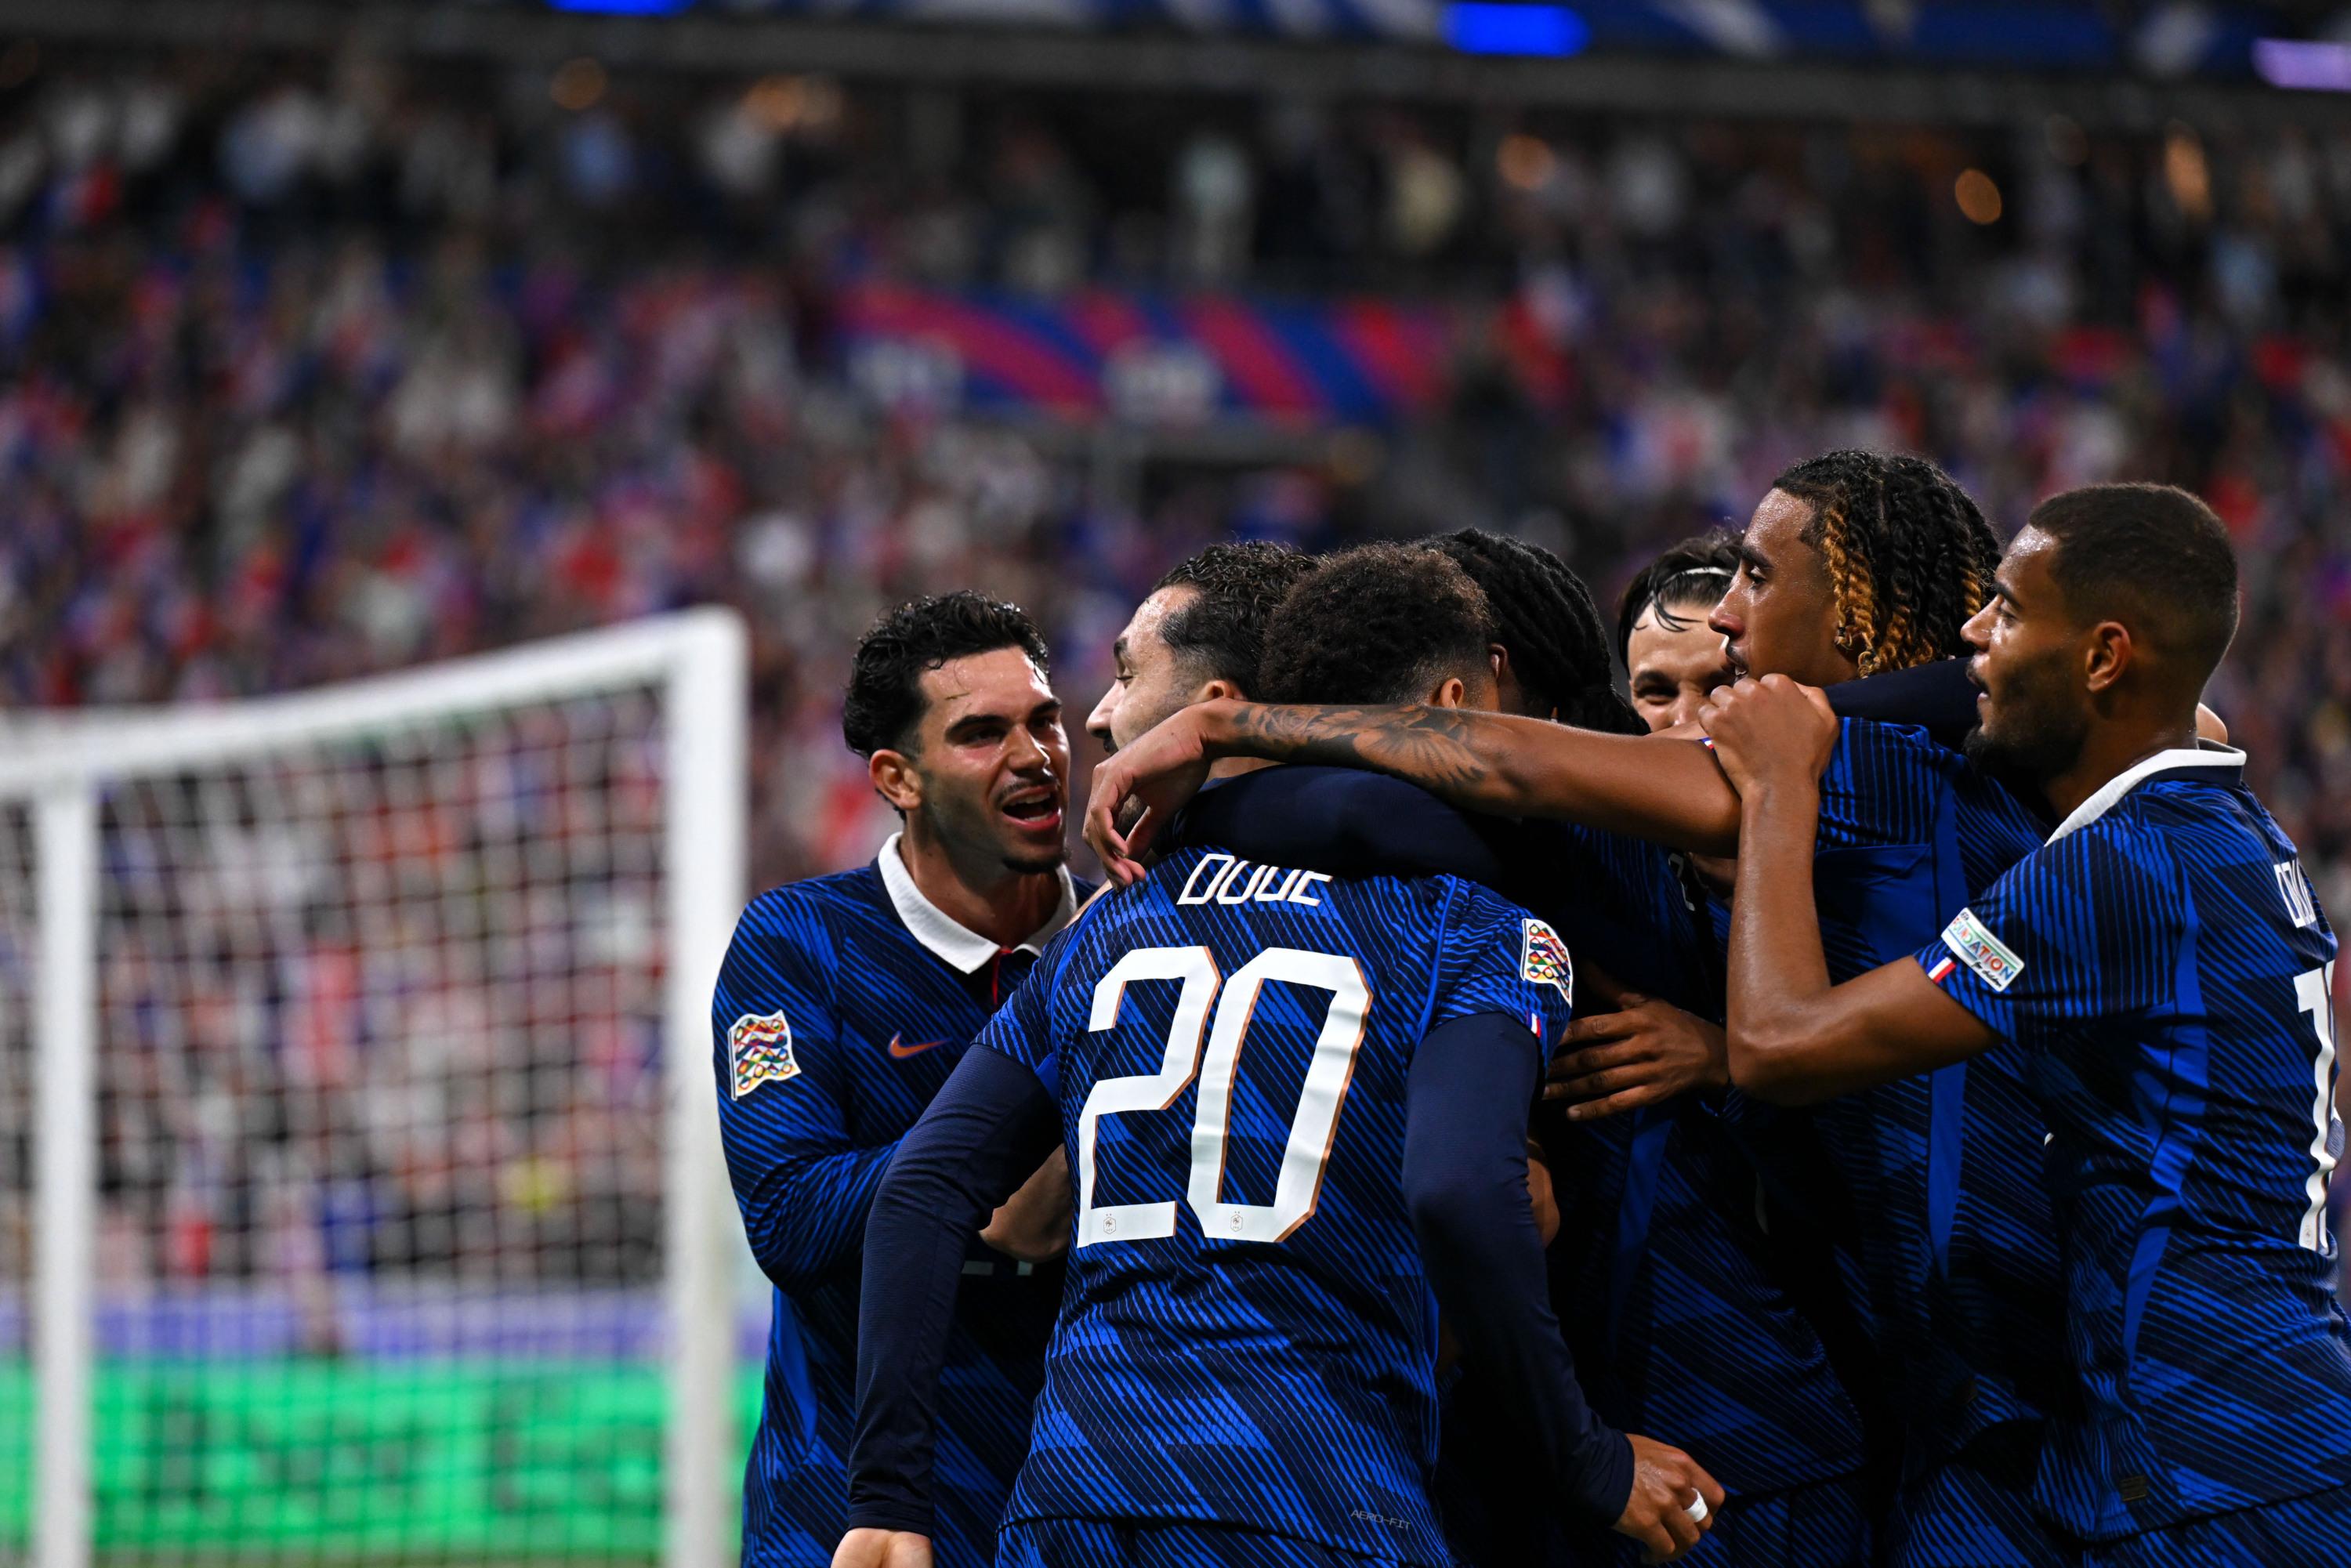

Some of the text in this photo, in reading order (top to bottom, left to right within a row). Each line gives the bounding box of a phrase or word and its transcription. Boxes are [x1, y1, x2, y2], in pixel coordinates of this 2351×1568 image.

[1077, 945, 1374, 1248] 20
[2293, 958, 2343, 1258] 1
[1350, 1509, 1411, 1530] AERO-FIT
